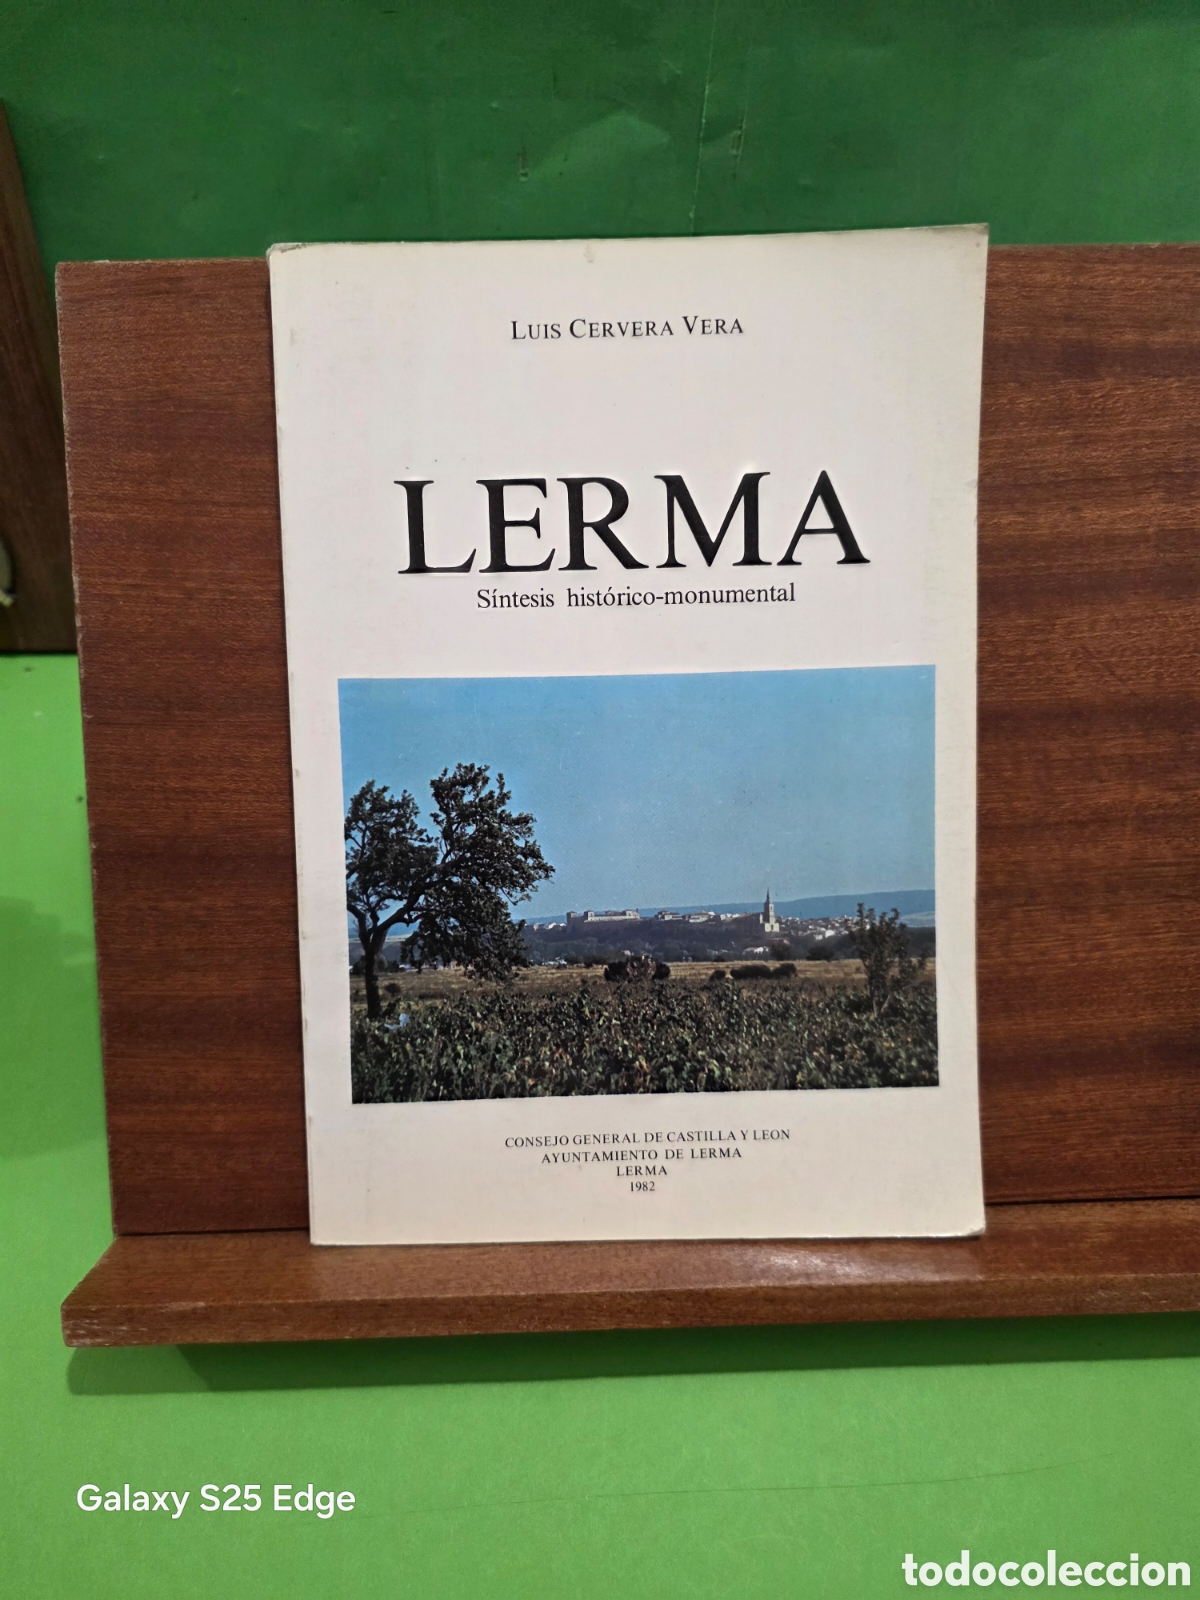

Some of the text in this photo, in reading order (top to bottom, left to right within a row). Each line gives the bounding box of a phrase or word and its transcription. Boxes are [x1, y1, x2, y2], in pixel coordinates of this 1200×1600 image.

[511, 316, 744, 341] LUIS CERVERA VERA
[393, 470, 871, 575] LERMA
[477, 582, 796, 609] Síntesis histórico-monumental
[504, 1129, 791, 1148] CONSEJO GENERAL DE CASTILLA Y LEON
[541, 1147, 742, 1164] AYUNTAMIENTO DE LERMA
[616, 1165, 668, 1177] LERMA
[629, 1181, 656, 1192] 1982
